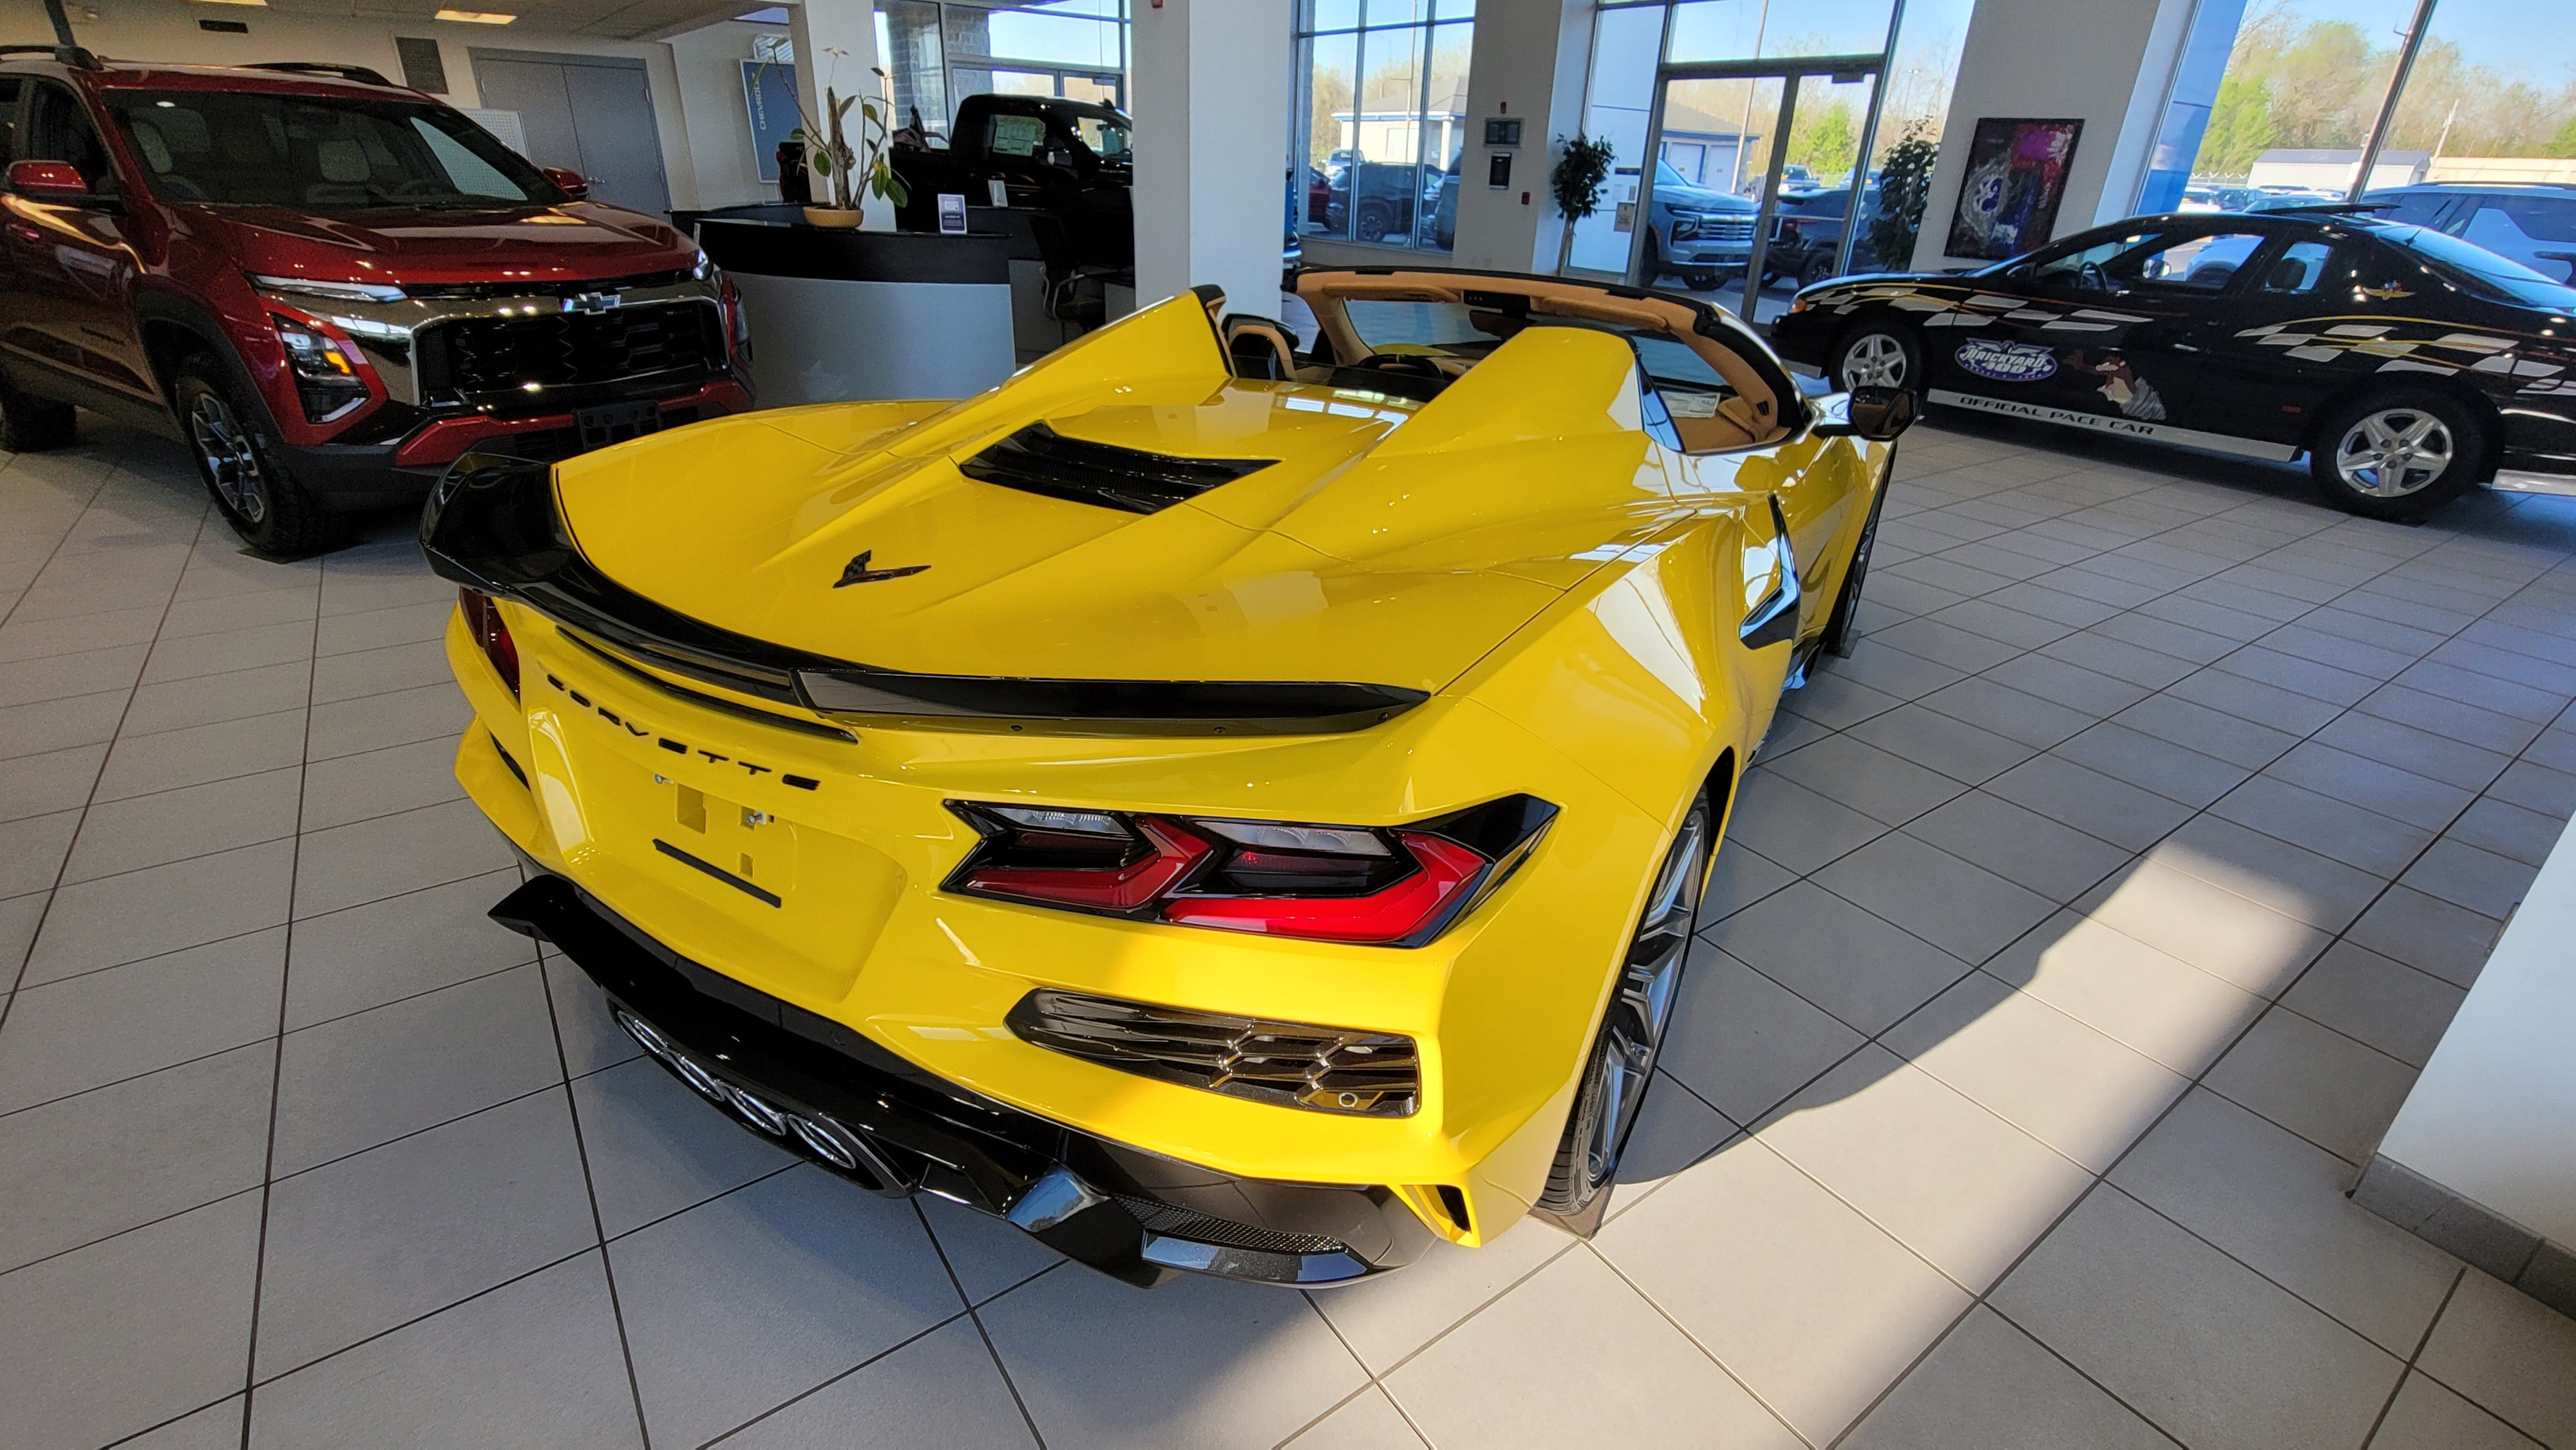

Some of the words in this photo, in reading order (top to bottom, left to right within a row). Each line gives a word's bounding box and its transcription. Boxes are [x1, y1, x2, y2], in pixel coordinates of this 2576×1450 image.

[1982, 362, 2027, 373] 400
[1960, 397, 2041, 417] OFFICIAL
[2049, 411, 2102, 426] PACE
[2109, 421, 2154, 435] CAR
[547, 674, 820, 791] CORVETTE
